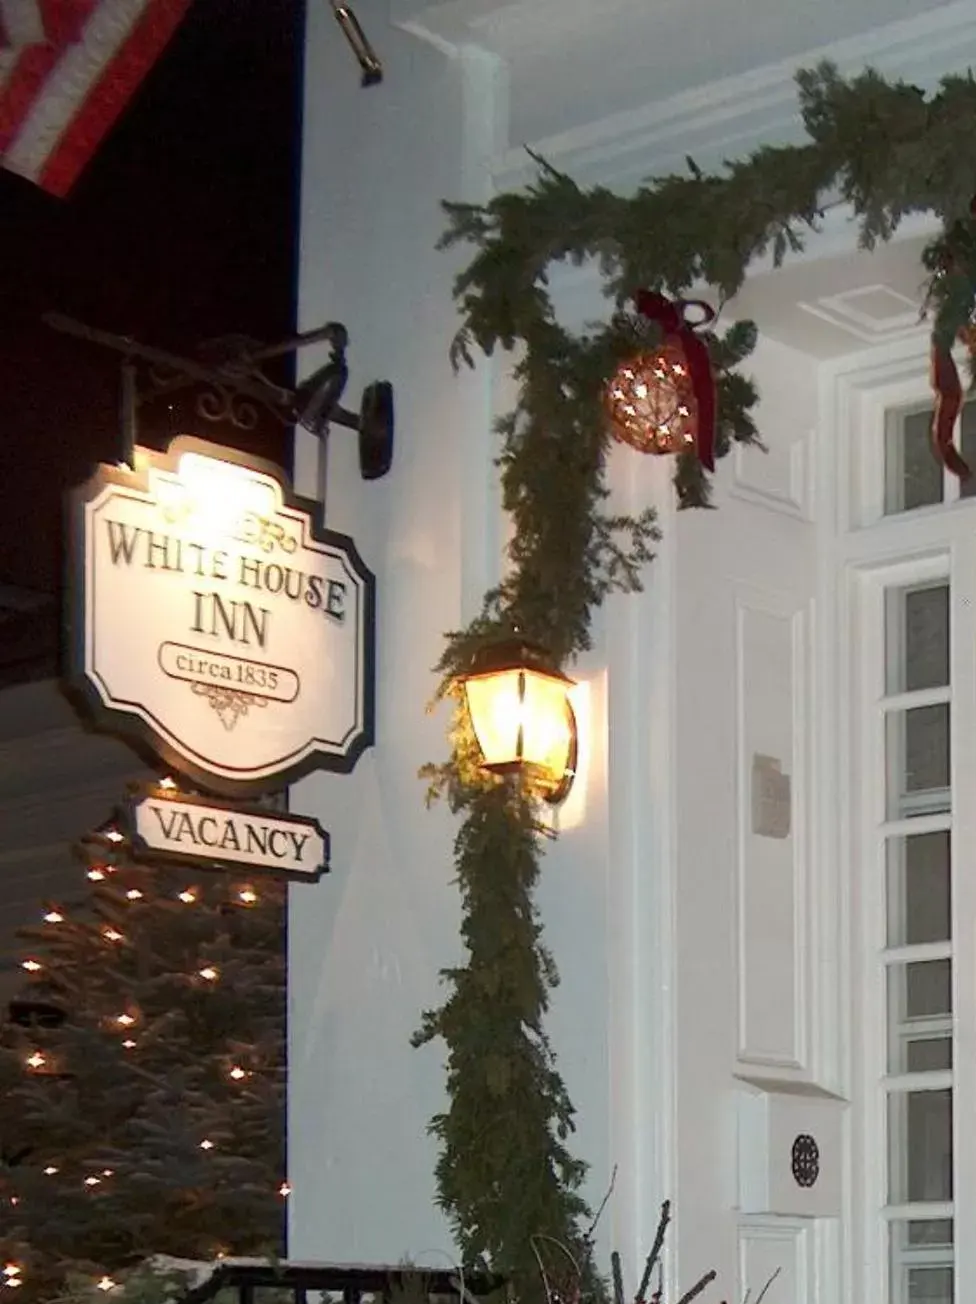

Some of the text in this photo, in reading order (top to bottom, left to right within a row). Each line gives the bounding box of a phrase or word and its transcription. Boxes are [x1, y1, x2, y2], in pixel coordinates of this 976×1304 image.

[104, 518, 347, 621] WHITE HOUSE
[189, 590, 271, 648] INN
[176, 654, 279, 690] circa 1835
[149, 806, 311, 862] VACANCY
